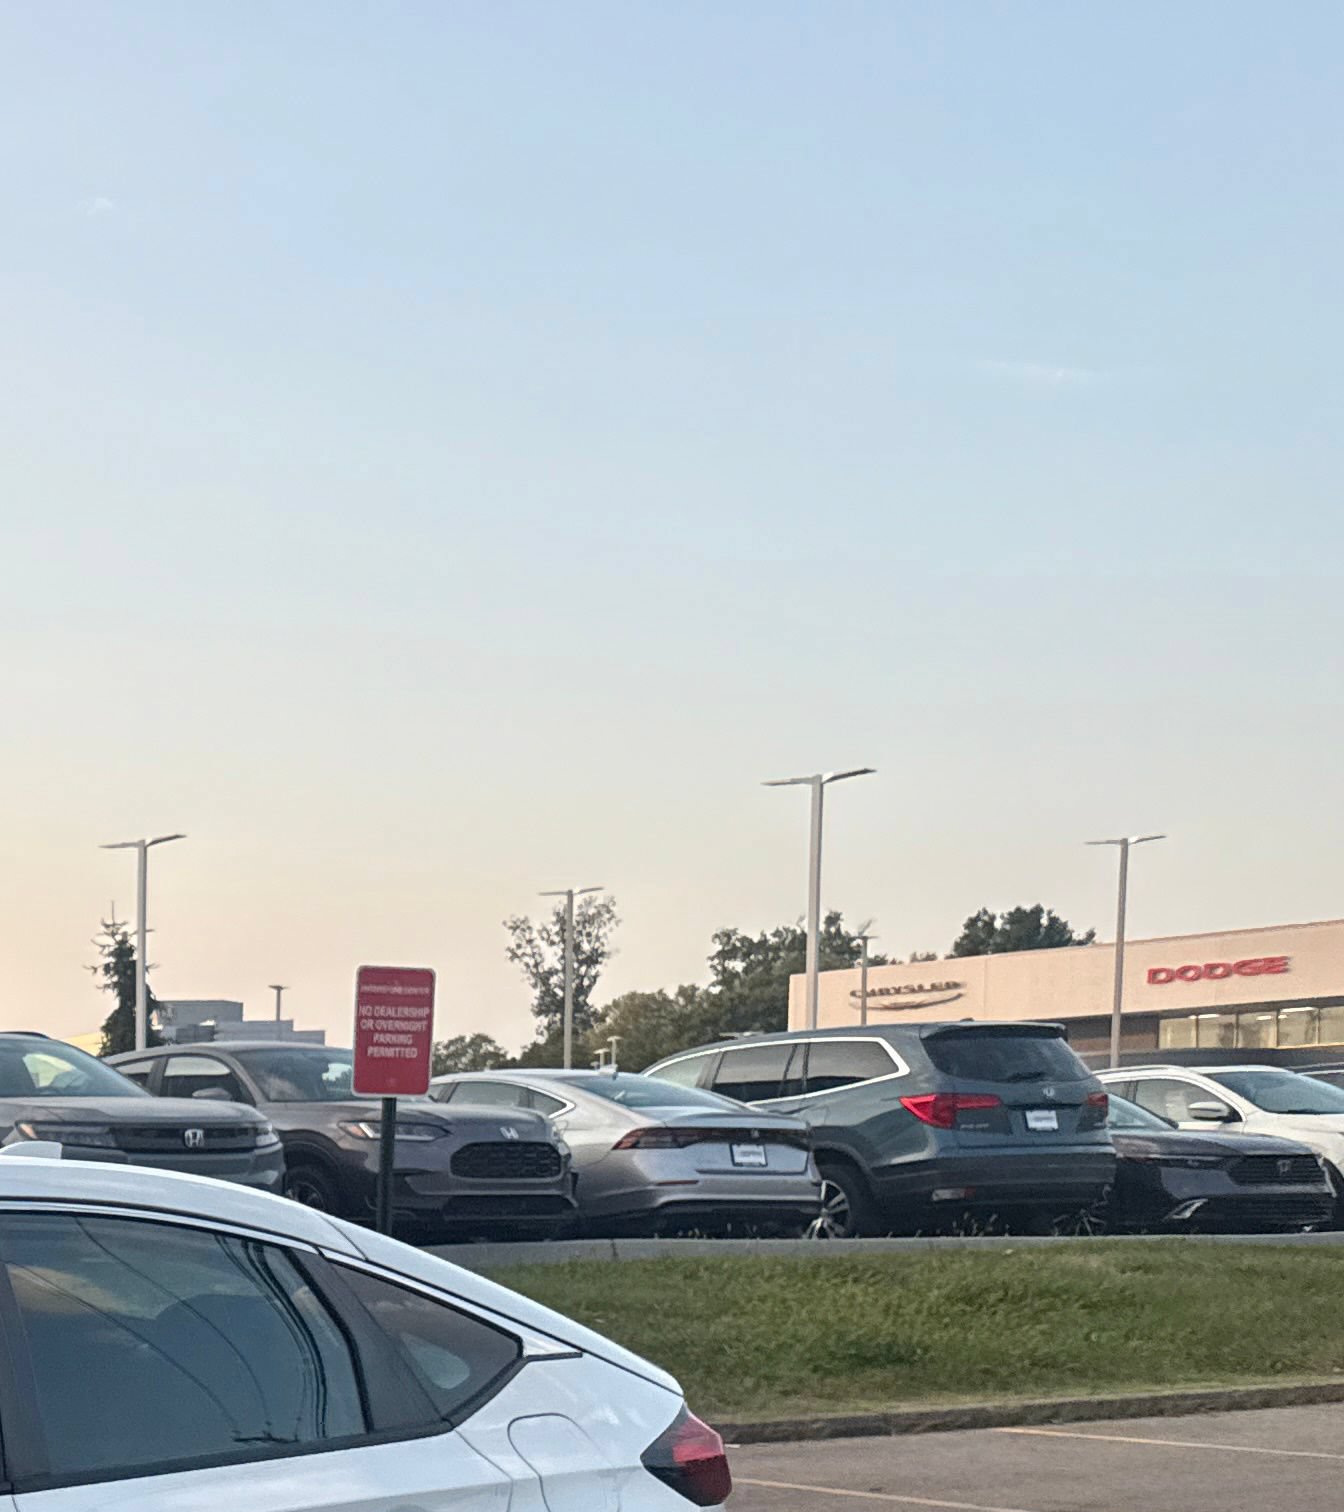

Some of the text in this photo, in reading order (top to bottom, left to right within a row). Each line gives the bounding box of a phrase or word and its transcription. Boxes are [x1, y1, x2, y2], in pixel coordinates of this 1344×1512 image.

[1147, 955, 1290, 985] DODGE
[358, 1005, 431, 1018] NO DEALERSHIP
[359, 1019, 428, 1032] OR OVERNIGHT
[373, 1033, 413, 1045] PARKING
[367, 1046, 418, 1058] PERMITTED
